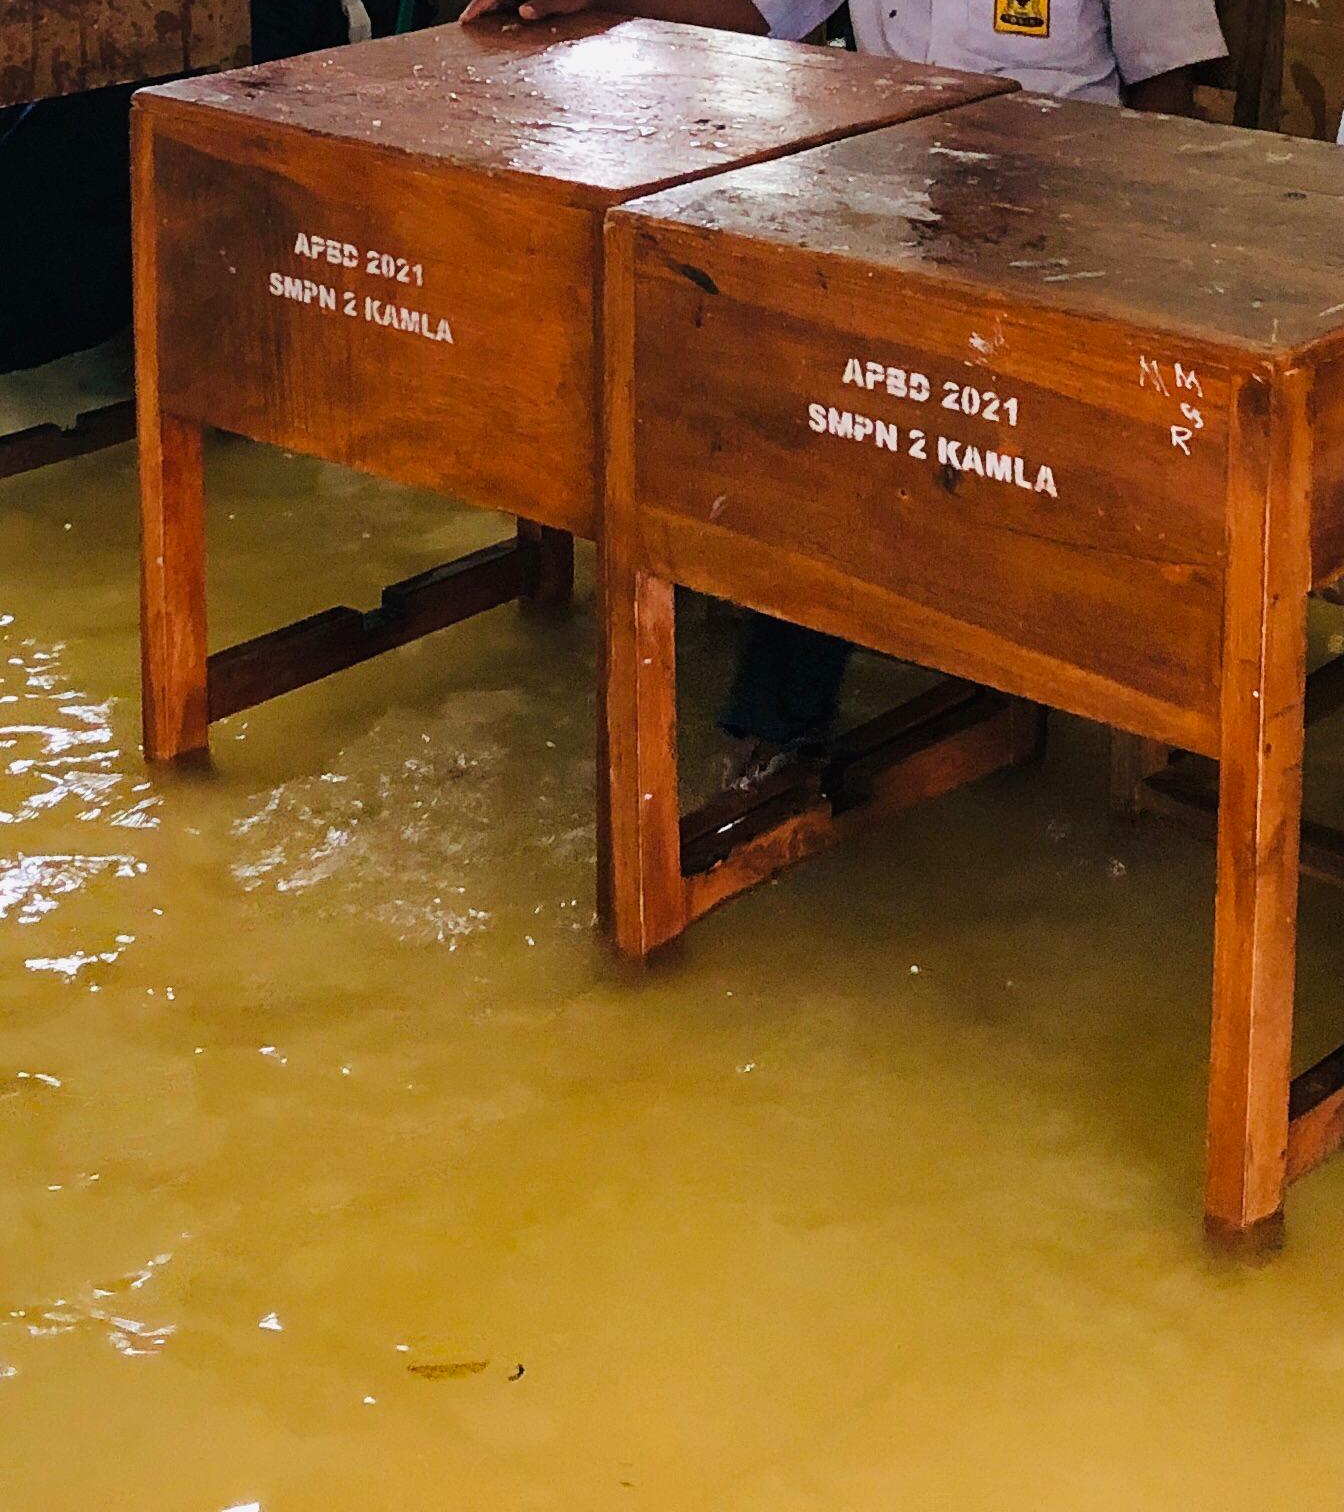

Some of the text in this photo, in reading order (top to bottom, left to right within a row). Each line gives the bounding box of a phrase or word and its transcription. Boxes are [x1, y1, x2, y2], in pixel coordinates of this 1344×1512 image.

[294, 232, 424, 287] APBD 2021
[269, 272, 454, 344] SMPN 2 KAMLA
[841, 358, 1019, 427] APBD 2021
[808, 403, 1058, 498] SMPN 2 KAMLA
